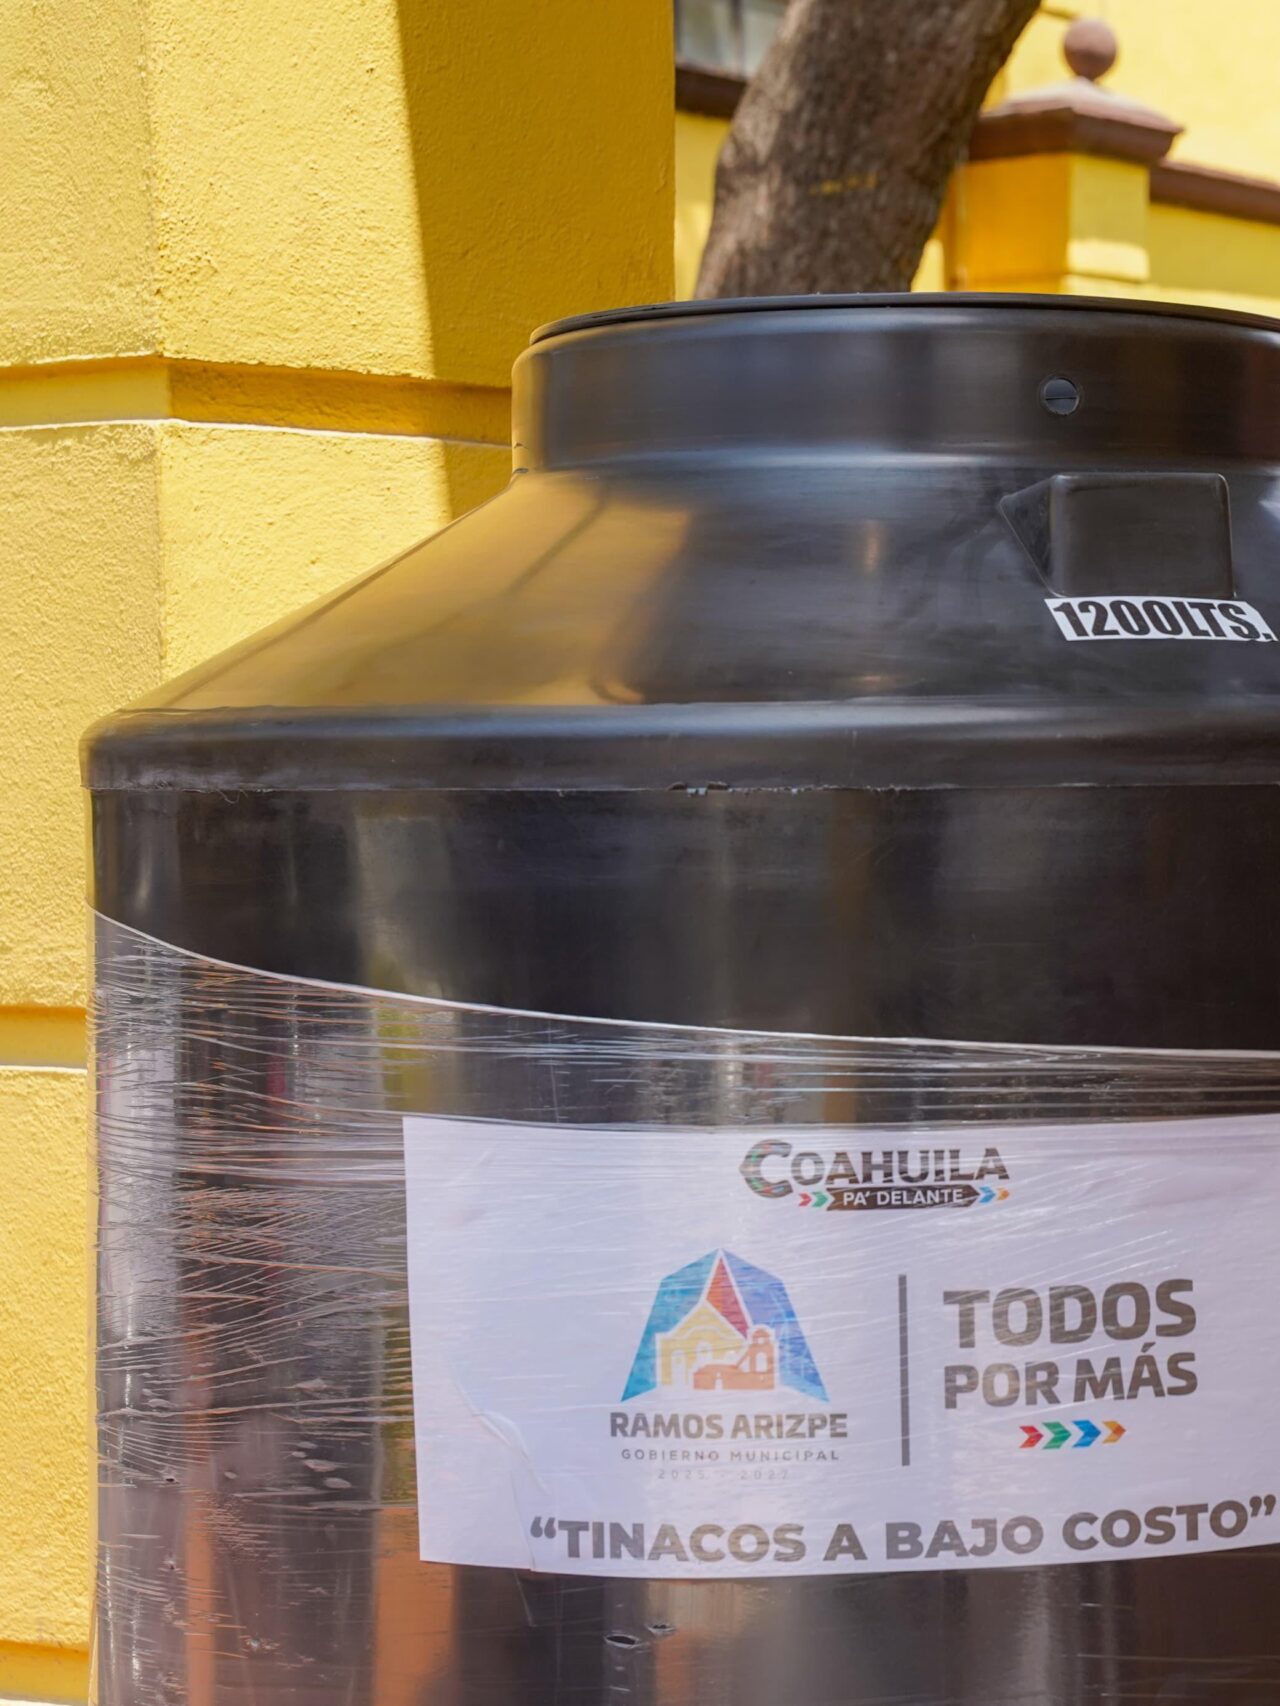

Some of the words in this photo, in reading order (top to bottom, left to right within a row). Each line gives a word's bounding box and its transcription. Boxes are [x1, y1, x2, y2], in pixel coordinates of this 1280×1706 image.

[738, 1138, 1010, 1199] COAHUILA
[876, 1188, 963, 1206] DELANTE
[943, 1278, 1197, 1349] TODOS
[944, 1361, 1061, 1410] POR
[1072, 1341, 1198, 1403] MÁS
[610, 1411, 724, 1439] RAMOS
[730, 1413, 848, 1439] ARIZPE
[621, 1448, 720, 1462] GOBIERNO
[730, 1450, 839, 1462] MUNICIPAL
[530, 1515, 805, 1563] “TINACOS
[823, 1523, 867, 1561] A
[885, 1515, 1044, 1561] BAJO
[1062, 1494, 1277, 1551] COSTO”
